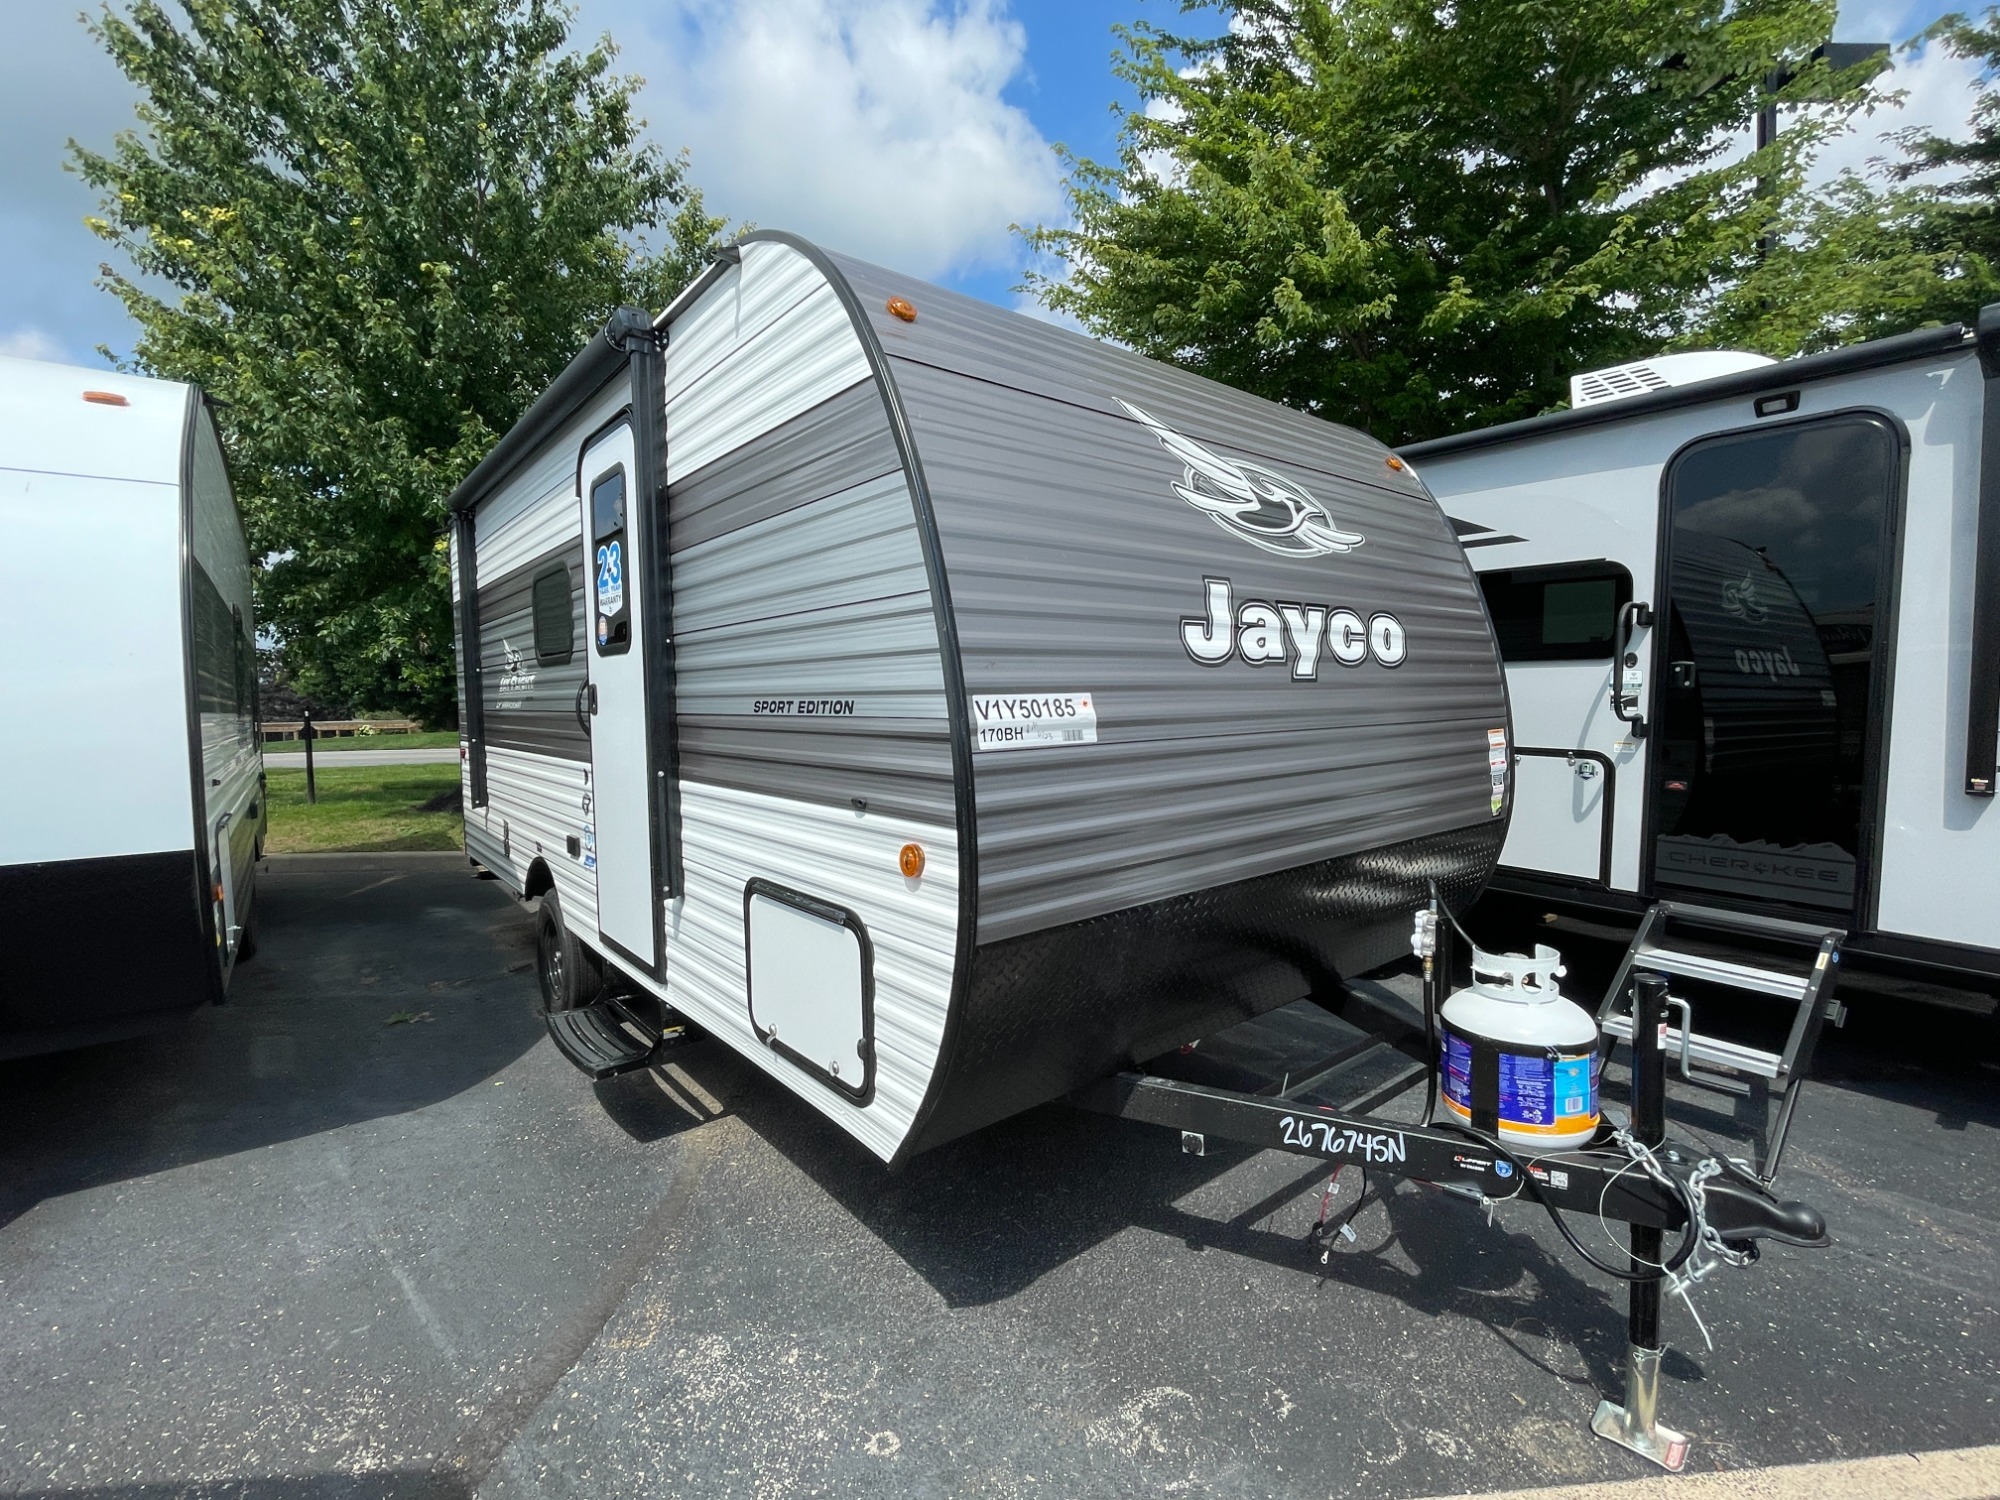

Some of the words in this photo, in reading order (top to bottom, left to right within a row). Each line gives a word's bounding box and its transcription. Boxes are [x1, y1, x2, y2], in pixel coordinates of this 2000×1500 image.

[600, 594, 622, 607] WARRANTY
[1180, 575, 1407, 683] Jayco
[753, 700, 794, 713] SPORT
[797, 700, 855, 714] EDITION
[974, 698, 1076, 720] V1Y50185
[980, 727, 1024, 742] 170BH
[1279, 1116, 1406, 1163] 2676745N
